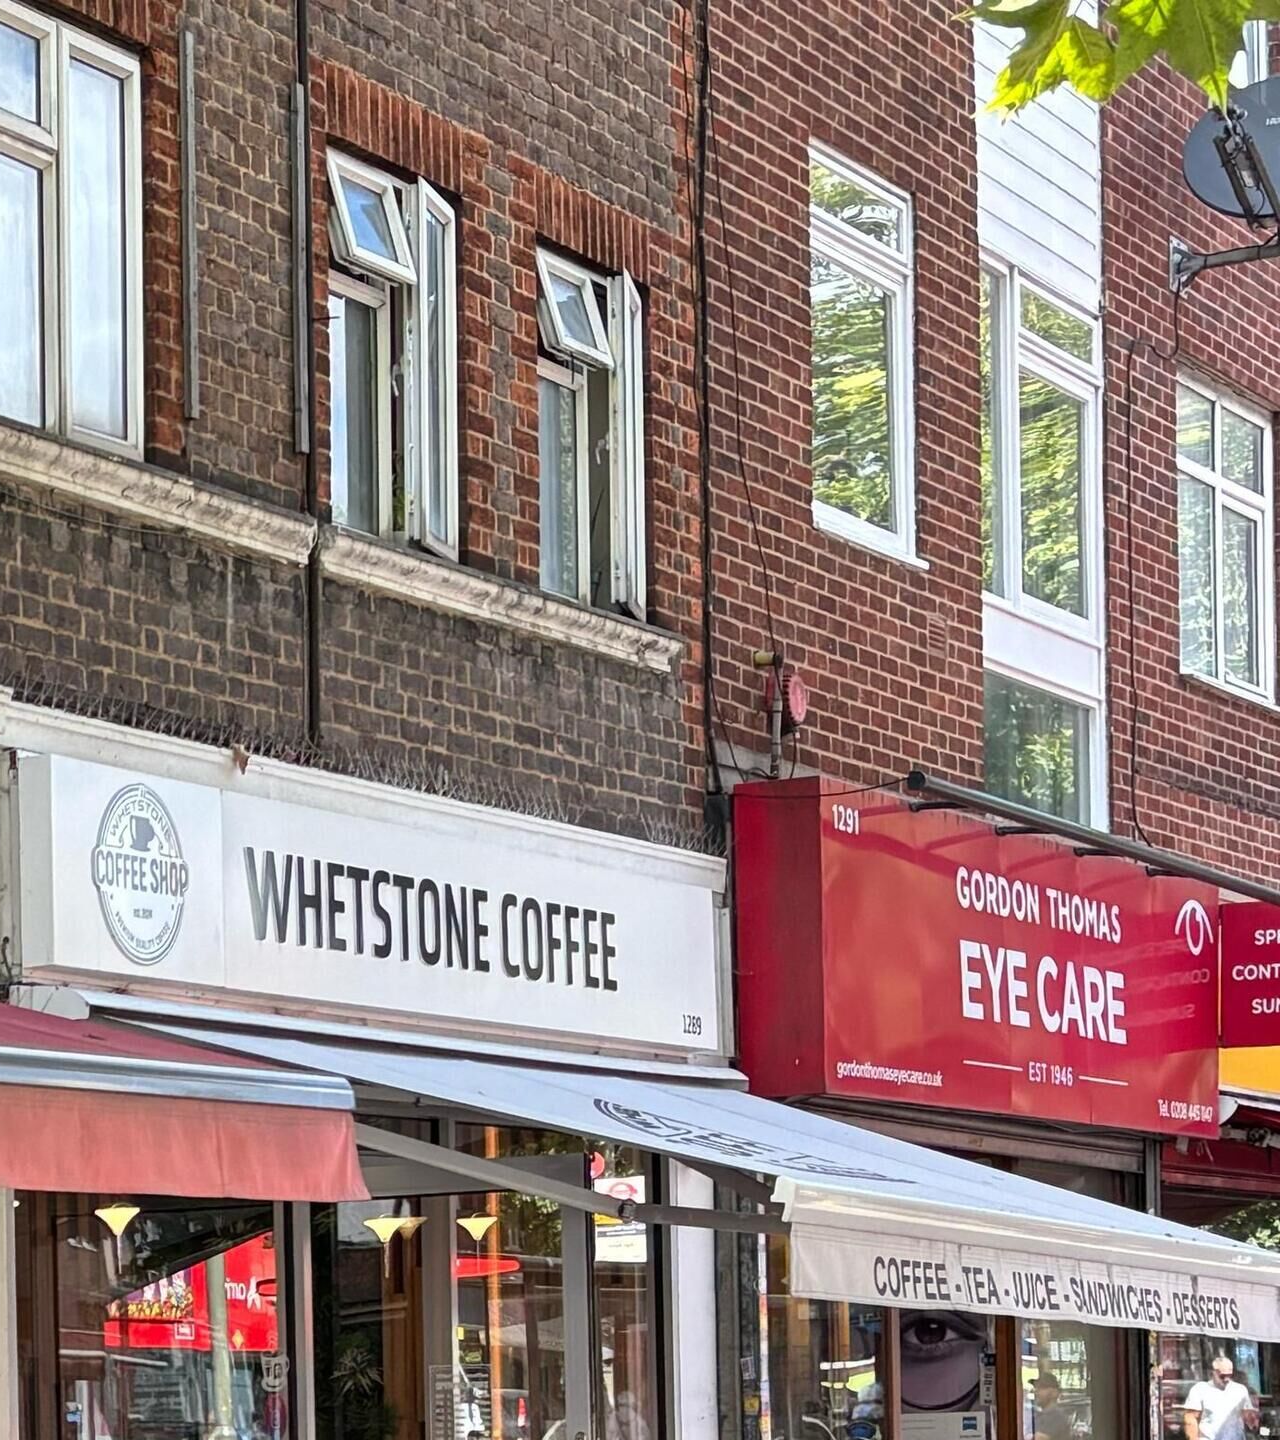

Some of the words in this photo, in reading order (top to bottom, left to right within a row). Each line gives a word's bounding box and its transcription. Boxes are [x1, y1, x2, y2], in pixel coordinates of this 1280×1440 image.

[832, 804, 860, 835] 1291
[96, 849, 148, 893] COFFEE
[150, 858, 189, 898] SHOP
[243, 846, 490, 973] WHETSTONE
[501, 893, 618, 992] COFFEE
[955, 865, 1041, 926] GORDON
[1045, 887, 1121, 945] THOMAS
[959, 939, 1031, 1029] EYE
[1036, 955, 1127, 1046] CARE
[682, 1013, 702, 1036] 1289
[836, 1059, 943, 1087] gordonthomaseyecare.co.uk
[1028, 1060, 1048, 1085] EST
[1049, 1063, 1074, 1088] 1946
[874, 1255, 951, 1301] COFFEE
[961, 1266, 1000, 1306] TEA
[1011, 1270, 1060, 1311] JUICE
[1069, 1276, 1163, 1324] SANDWICHES
[1172, 1292, 1241, 1331] DESSERTS
